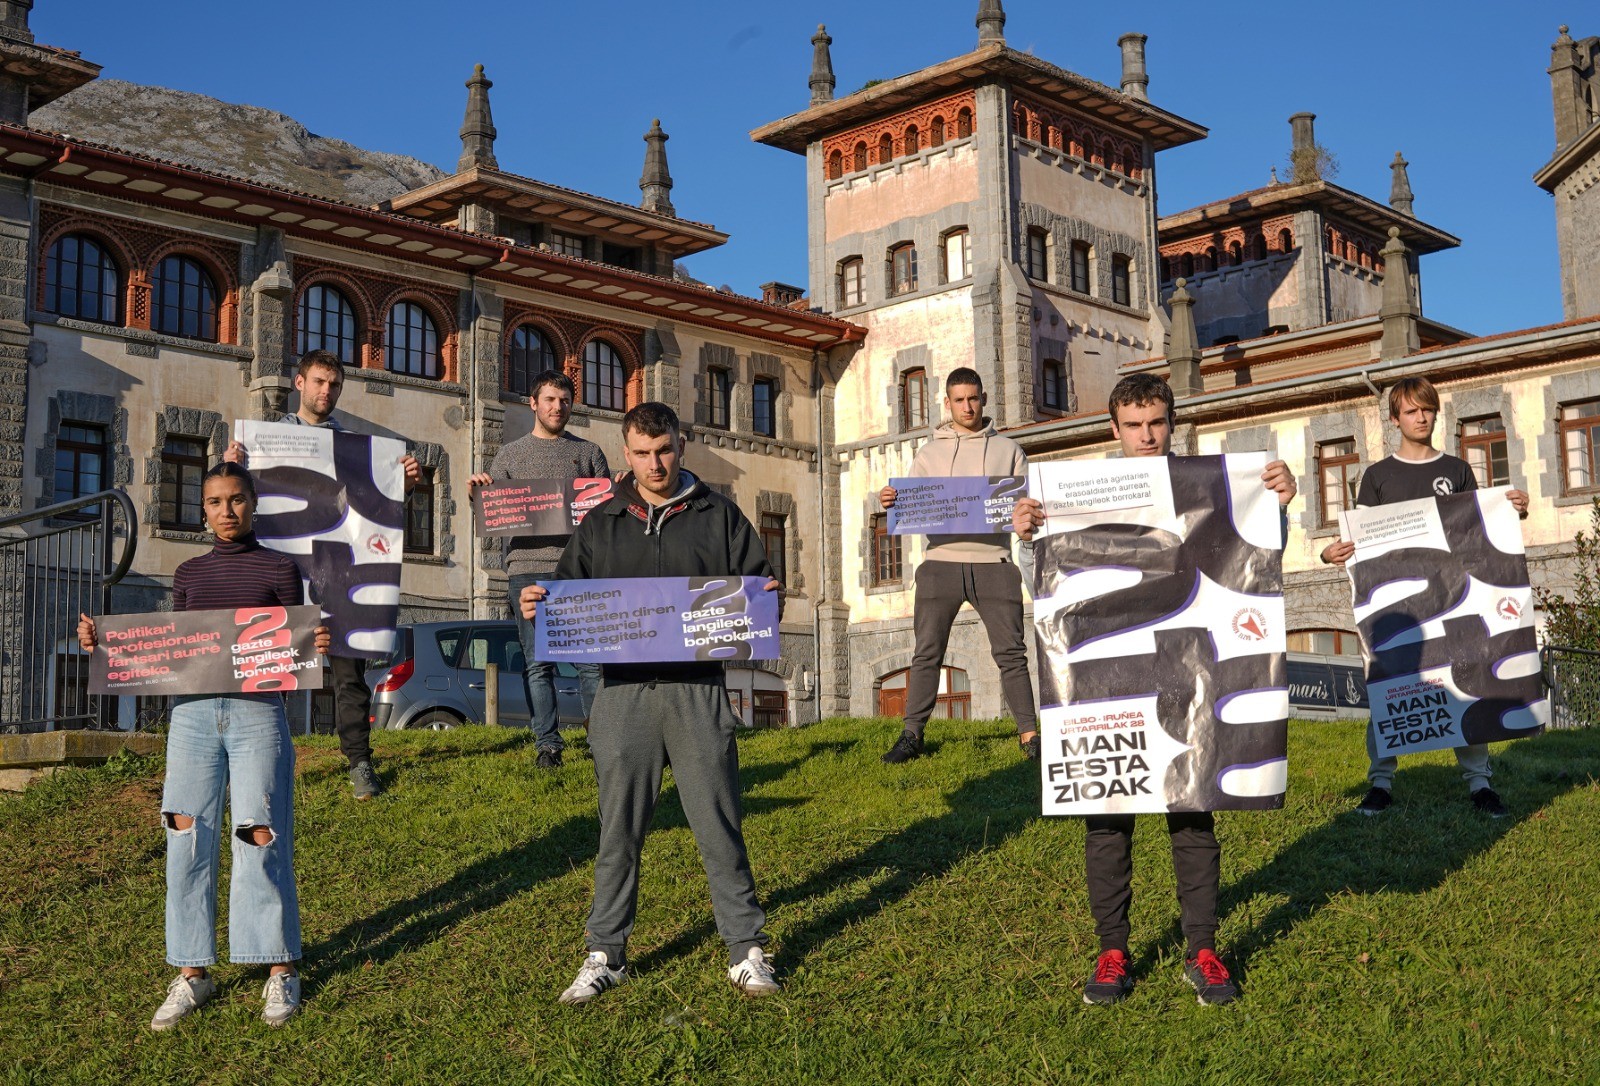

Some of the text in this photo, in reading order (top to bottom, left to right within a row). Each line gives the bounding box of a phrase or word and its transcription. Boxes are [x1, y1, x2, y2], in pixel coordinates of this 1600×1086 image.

[897, 484, 944, 494] angileon
[1058, 478, 1094, 490] Enpresari
[1110, 472, 1149, 484] agintarien
[481, 486, 531, 498] Politikari
[1065, 482, 1150, 498] erasoaldiaren aurrean,
[483, 492, 564, 509] profesionalen
[570, 500, 600, 508] gazte
[894, 494, 980, 510] aberasten diren
[984, 496, 1014, 507] gazte
[1053, 490, 1151, 510] gazte langileok borrokara!
[484, 501, 564, 517] fartsari aurre
[895, 504, 958, 518] enpresariei
[928, 511, 968, 522] egiteko
[984, 506, 1016, 516] langil
[485, 515, 526, 527] egiteko
[544, 589, 622, 606] Langileon
[545, 602, 607, 616] kontura
[546, 605, 675, 627] aberasten diren
[681, 606, 725, 621] gazte
[106, 622, 176, 642] Politikari
[547, 619, 641, 638] enpresariei
[682, 616, 753, 633] langileok
[108, 631, 220, 657] profesionalen
[548, 630, 657, 648] aurre egiteko
[684, 627, 772, 647] borrokara!
[231, 639, 273, 654] gazte
[108, 645, 220, 668] fartsari aurre
[232, 648, 300, 665] langileok
[108, 665, 170, 680] egiteko
[234, 658, 318, 679] borrokara!
[1387, 685, 1410, 694] BILBO
[1387, 691, 1448, 716] MANI
[1060, 720, 1145, 734] URTARRILAK 28
[1064, 711, 1144, 726] BILBO IRUÑEA
[1378, 707, 1452, 734] FESTA
[1061, 731, 1146, 757] MANI
[1384, 722, 1455, 749] ZIOAK
[1048, 754, 1150, 782] FESTA
[1054, 776, 1152, 804] ZIOAK
